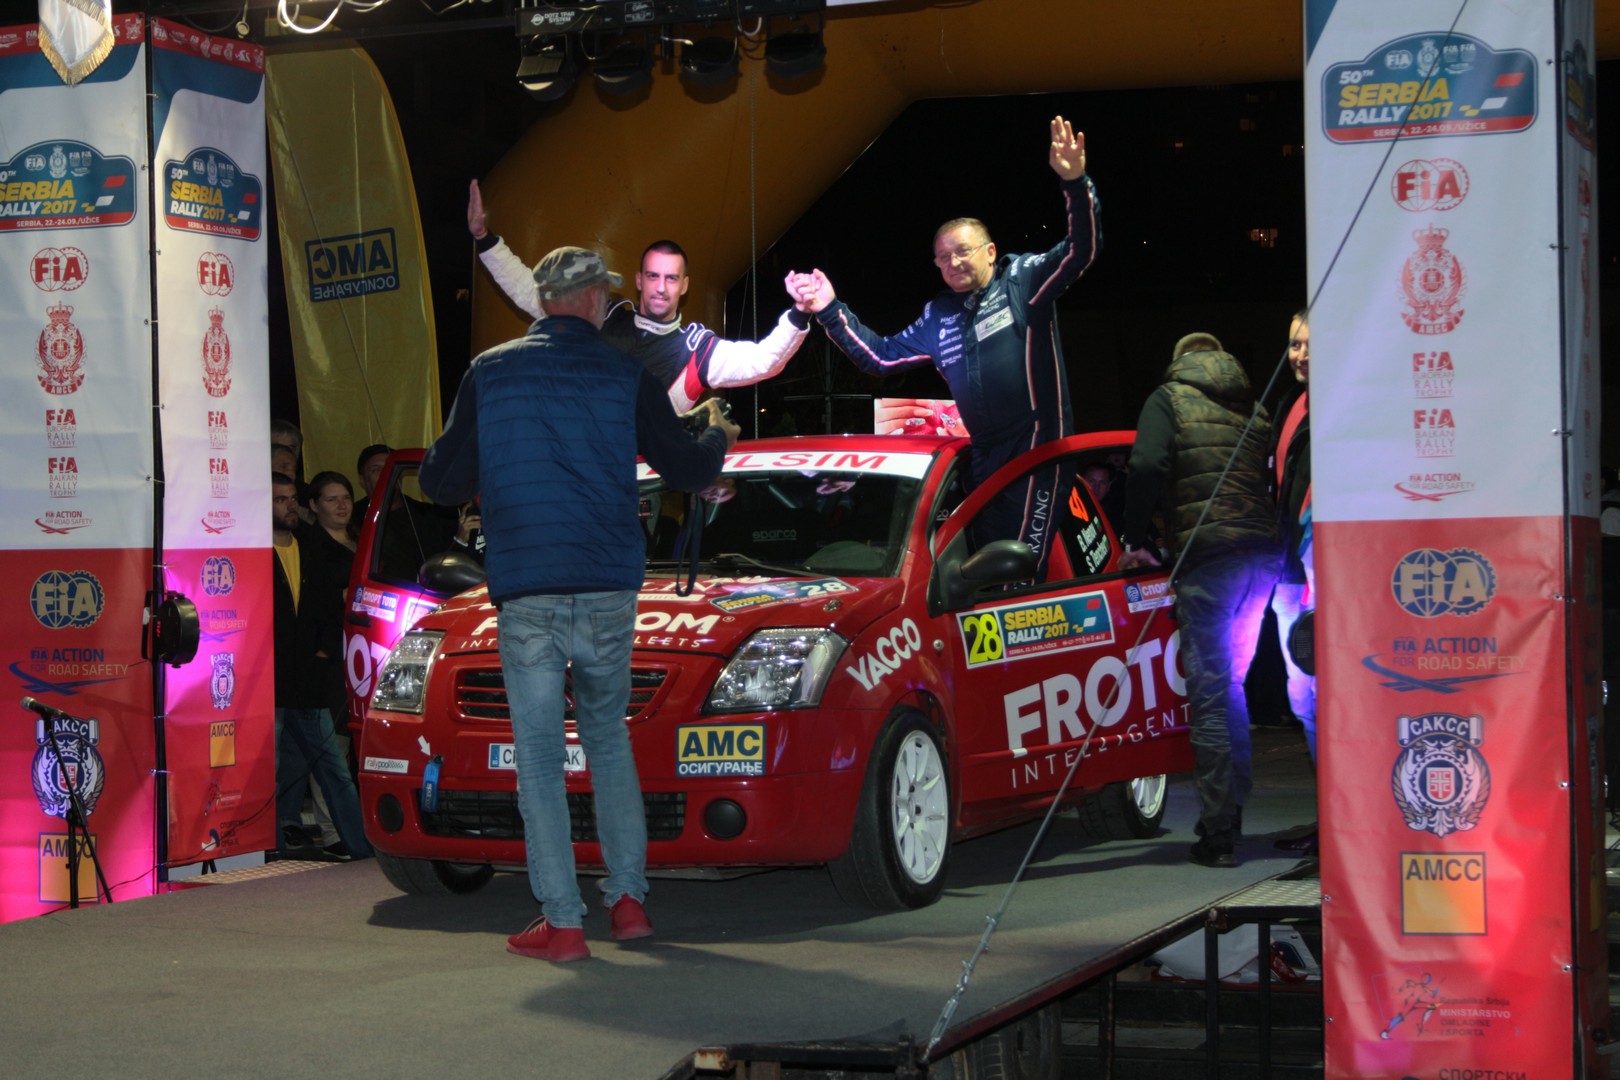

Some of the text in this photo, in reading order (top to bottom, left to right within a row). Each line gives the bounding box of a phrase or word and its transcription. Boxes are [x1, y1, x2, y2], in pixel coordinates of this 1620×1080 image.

[1338, 78, 1449, 108] SERBIA
[1338, 101, 1453, 126] RALLY 2017
[170, 180, 223, 206] SERBIA
[41, 200, 77, 214] 2017
[171, 200, 225, 221] RALLY 2017
[1415, 379, 1453, 389] RALLY
[48, 432, 76, 440] RALLY
[1415, 439, 1455, 449] RALLY
[1424, 472, 1462, 482] ACTION
[49, 481, 78, 489] RALLY
[56, 510, 83, 519] ACTION
[1026, 489, 1050, 553] RACING
[801, 582, 847, 596] 28
[1141, 582, 1169, 596] СПОР
[211, 609, 237, 619] ACTION
[1004, 604, 1066, 631] SERBIA
[964, 613, 1002, 664] 28
[1007, 627, 1044, 645] RALLY
[1044, 622, 1069, 638] 2017
[1423, 637, 1497, 654] ACTION
[52, 648, 104, 662] ACTION
[846, 617, 923, 691] YACCO
[49, 664, 79, 675] ROAD
[82, 663, 128, 675] SAFETY
[1418, 656, 1462, 671] ROAD
[1466, 655, 1527, 670] SAFETY
[1440, 1008, 1511, 1019] MINISTARSTVO
